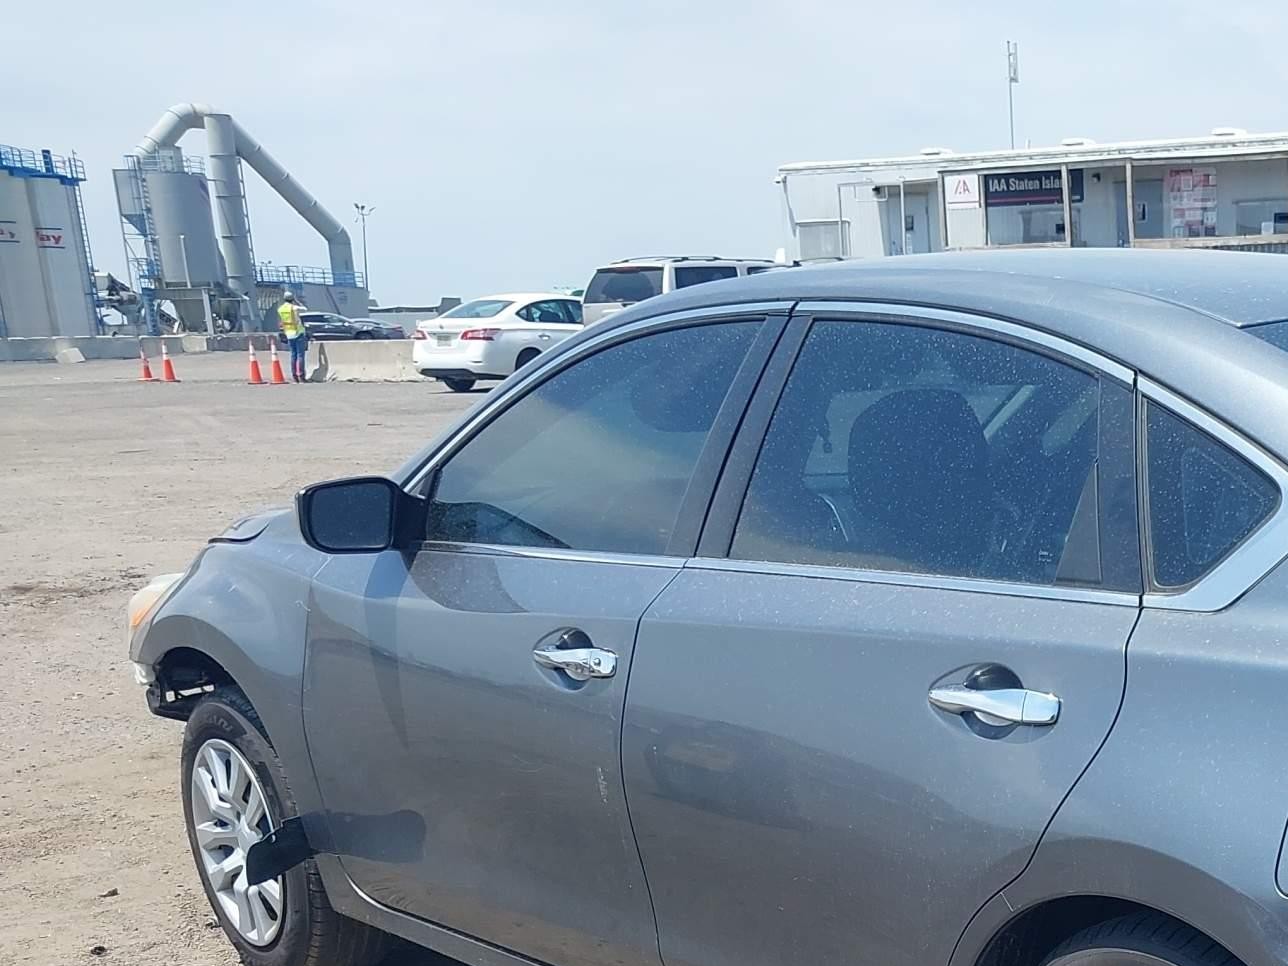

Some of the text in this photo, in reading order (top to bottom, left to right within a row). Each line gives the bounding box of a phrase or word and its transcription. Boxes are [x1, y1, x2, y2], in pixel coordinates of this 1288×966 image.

[990, 175, 1071, 192] IAA Staten Isla
